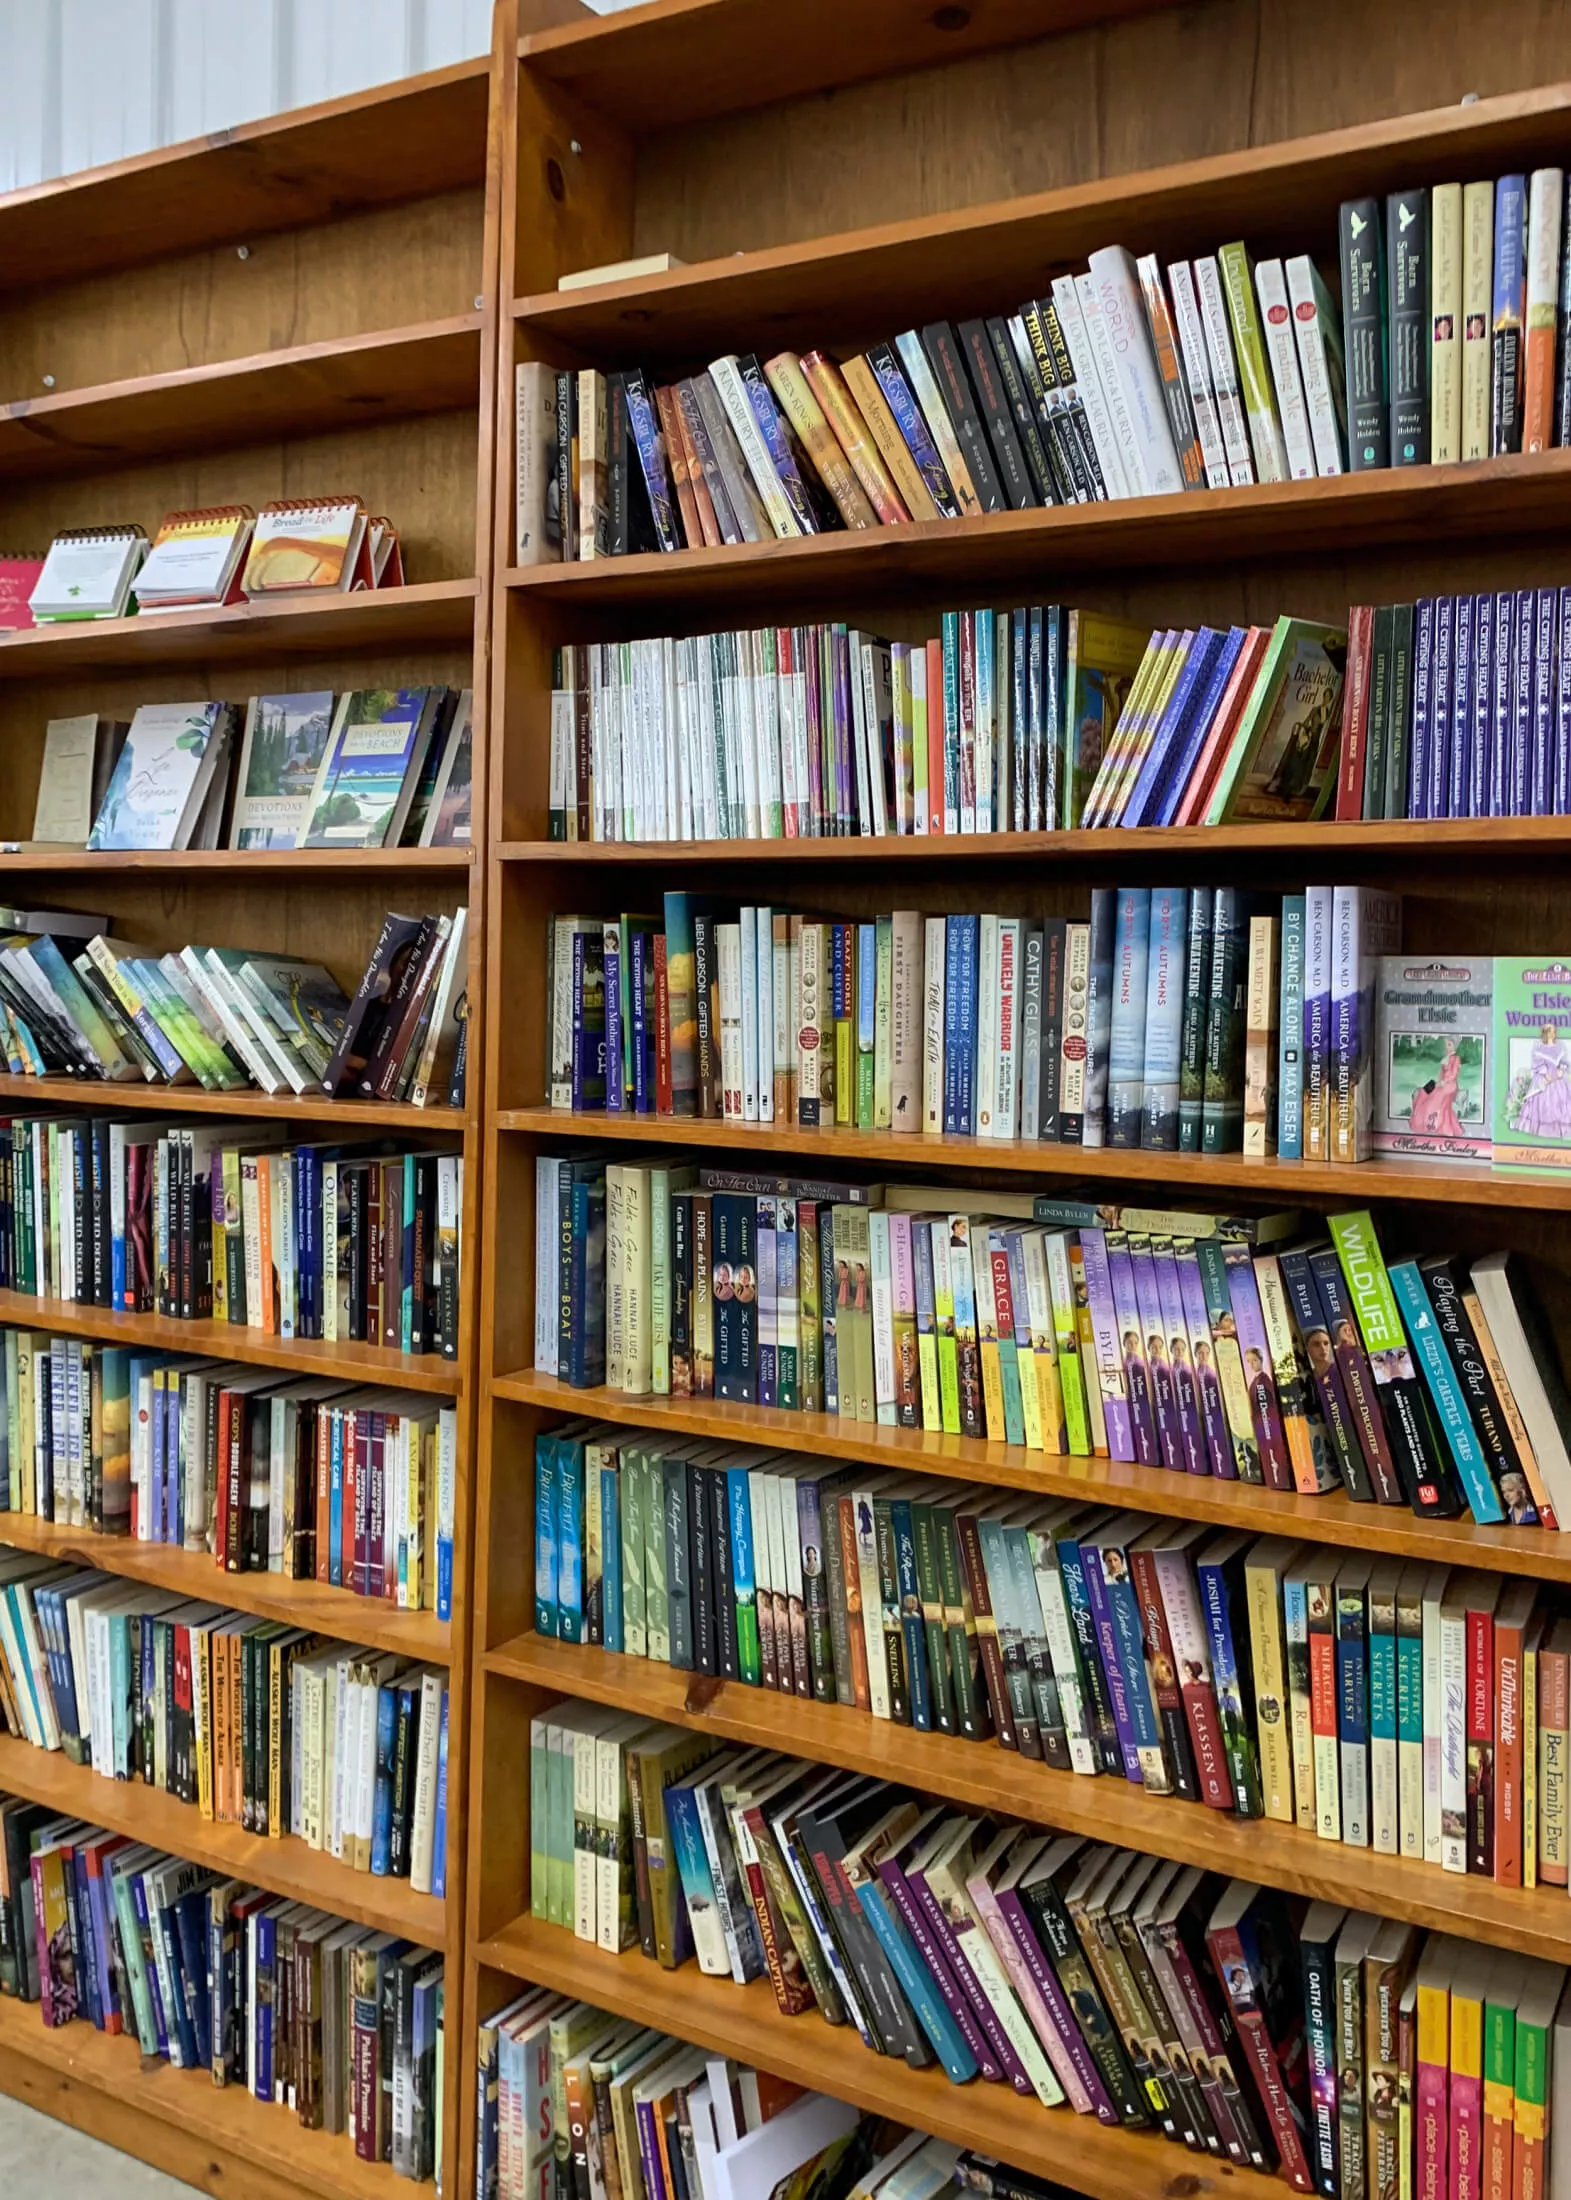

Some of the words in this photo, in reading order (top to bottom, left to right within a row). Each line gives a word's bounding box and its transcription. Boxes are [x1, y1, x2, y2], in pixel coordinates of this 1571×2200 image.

[1024, 311, 1047, 355] THINK
[1100, 278, 1129, 354] WORLD
[1042, 306, 1063, 350] THINK
[1055, 353, 1072, 381] BIG
[1035, 358, 1056, 385] BIG
[559, 402, 567, 446] CARSON
[718, 370, 754, 441] KINGSBURY
[1357, 417, 1379, 426] Wendy
[1398, 415, 1420, 424] Wendy
[560, 454, 568, 490] GIFTED
[1523, 599, 1531, 620] THE
[1521, 622, 1530, 662] CRYING
[1540, 620, 1550, 660] CRYING
[1293, 663, 1339, 684] Bachelor
[1540, 662, 1548, 696] HEART
[1295, 687, 1319, 704] Girl
[696, 923, 704, 946] BEN
[949, 929, 957, 952] ROW
[962, 929, 970, 952] ROW
[1289, 913, 1299, 931] BY
[607, 961, 617, 976] My
[696, 948, 705, 993] CARSON
[949, 956, 957, 977] FOR
[962, 956, 970, 977] FOR
[1001, 934, 1012, 990] UNLIKELY
[1027, 940, 1039, 997] CATHY
[1121, 945, 1131, 1004] AUTUMNS
[1189, 933, 1201, 997] AWAKENING
[1287, 935, 1299, 993] CHANCE
[608, 980, 617, 1008] Secret
[948, 980, 956, 1030] FREEDOM
[961, 980, 969, 1030] FREEDOM
[1383, 990, 1493, 1007] Grandmother
[608, 1012, 617, 1048] Mother
[698, 1001, 707, 1038] GIFTED
[1000, 995, 1012, 1051] WARRIOR
[1026, 1002, 1038, 1057] GLASS
[1286, 997, 1298, 1044] ALONE
[1311, 1000, 1321, 1048] AMERICA
[1339, 1001, 1349, 1049] AMERICA
[1418, 1008, 1457, 1023] Elsie
[700, 1040, 708, 1078] HANDS
[1313, 1050, 1321, 1062] the
[1341, 1052, 1349, 1063] the
[1285, 1066, 1297, 1097] MAX
[1311, 1064, 1320, 1121] BEAUTIFUL
[1339, 1065, 1348, 1122] BEAUTIFUL
[1285, 1102, 1296, 1142] EISEN
[625, 1187, 637, 1221] Fields
[325, 1176, 335, 1279] OVERCOMER
[562, 1221, 571, 1264] BOYS
[626, 1240, 637, 1273] Grace
[994, 1259, 1009, 1321] GRACE
[1340, 1223, 1388, 1343] WILDLIFE
[562, 1295, 571, 1340] BOAT
[613, 1285, 621, 1325] HANNAH
[629, 1289, 637, 1330] HANNAH
[1432, 1276, 1460, 1334] Playing
[629, 1334, 637, 1360] LUCE
[1099, 1331, 1117, 1385] BYLER
[1455, 1338, 1472, 1355] the
[68, 1355, 78, 1413] LOCKED
[1297, 1284, 1312, 1318] BYLER
[1330, 1402, 1349, 1451] WITNESSES
[1326, 1282, 1341, 1312] BYLER
[1359, 1406, 1379, 1455] DAUGHTER
[1463, 1360, 1485, 1396] Part
[1422, 1335, 1445, 1377] LIZZIE'S
[1436, 1379, 1463, 1425] CAREFREE
[1455, 1429, 1473, 1461] YEARS
[69, 1435, 79, 1459] ICE
[1479, 1405, 1502, 1453] TURANO
[230, 1478, 238, 1505] AGENT
[1062, 1563, 1083, 1604] Heart
[1207, 1575, 1220, 1614] JOSIAH
[1071, 1608, 1092, 1644] Land
[1100, 1622, 1118, 1662] Keeper
[1211, 1618, 1224, 1631] for
[889, 1636, 899, 1687] SNELLING
[1109, 1666, 1122, 1678] of
[1214, 1633, 1228, 1678] President
[1322, 1645, 1332, 1705] MIRACLE
[1112, 1681, 1129, 1722] Hearts
[1344, 1660, 1354, 1722] HARVEST
[1399, 1655, 1408, 1724] SECRETS
[1475, 1679, 1486, 1730] FORTUNE
[1501, 1657, 1517, 1746] UnThinkable
[422, 1701, 436, 1769] Elizabeth
[1192, 1702, 1215, 1773] KLASSEN
[1547, 1733, 1561, 1768] Best
[419, 1776, 434, 1816] Smart
[1541, 1771, 1563, 1823] Family
[1546, 1827, 1561, 1860] Ever
[756, 1896, 774, 1946] INDIAN
[768, 1948, 786, 2004] CAPTIVE
[892, 1881, 925, 1943] ABANDONED
[924, 1946, 954, 1998] MEMORIES
[955, 2008, 979, 2051] TYNDALL
[1309, 1972, 1320, 2006] OATH
[1311, 2009, 1322, 2026] OF
[360, 2035, 371, 2080] Pukka's
[1313, 2029, 1326, 2077] HONOR
[360, 2084, 371, 2132] Promise
[1317, 2104, 1330, 2139] LYNETTE
[1320, 2142, 1333, 2170] EASON
[1378, 2130, 1386, 2189] PETERSON
